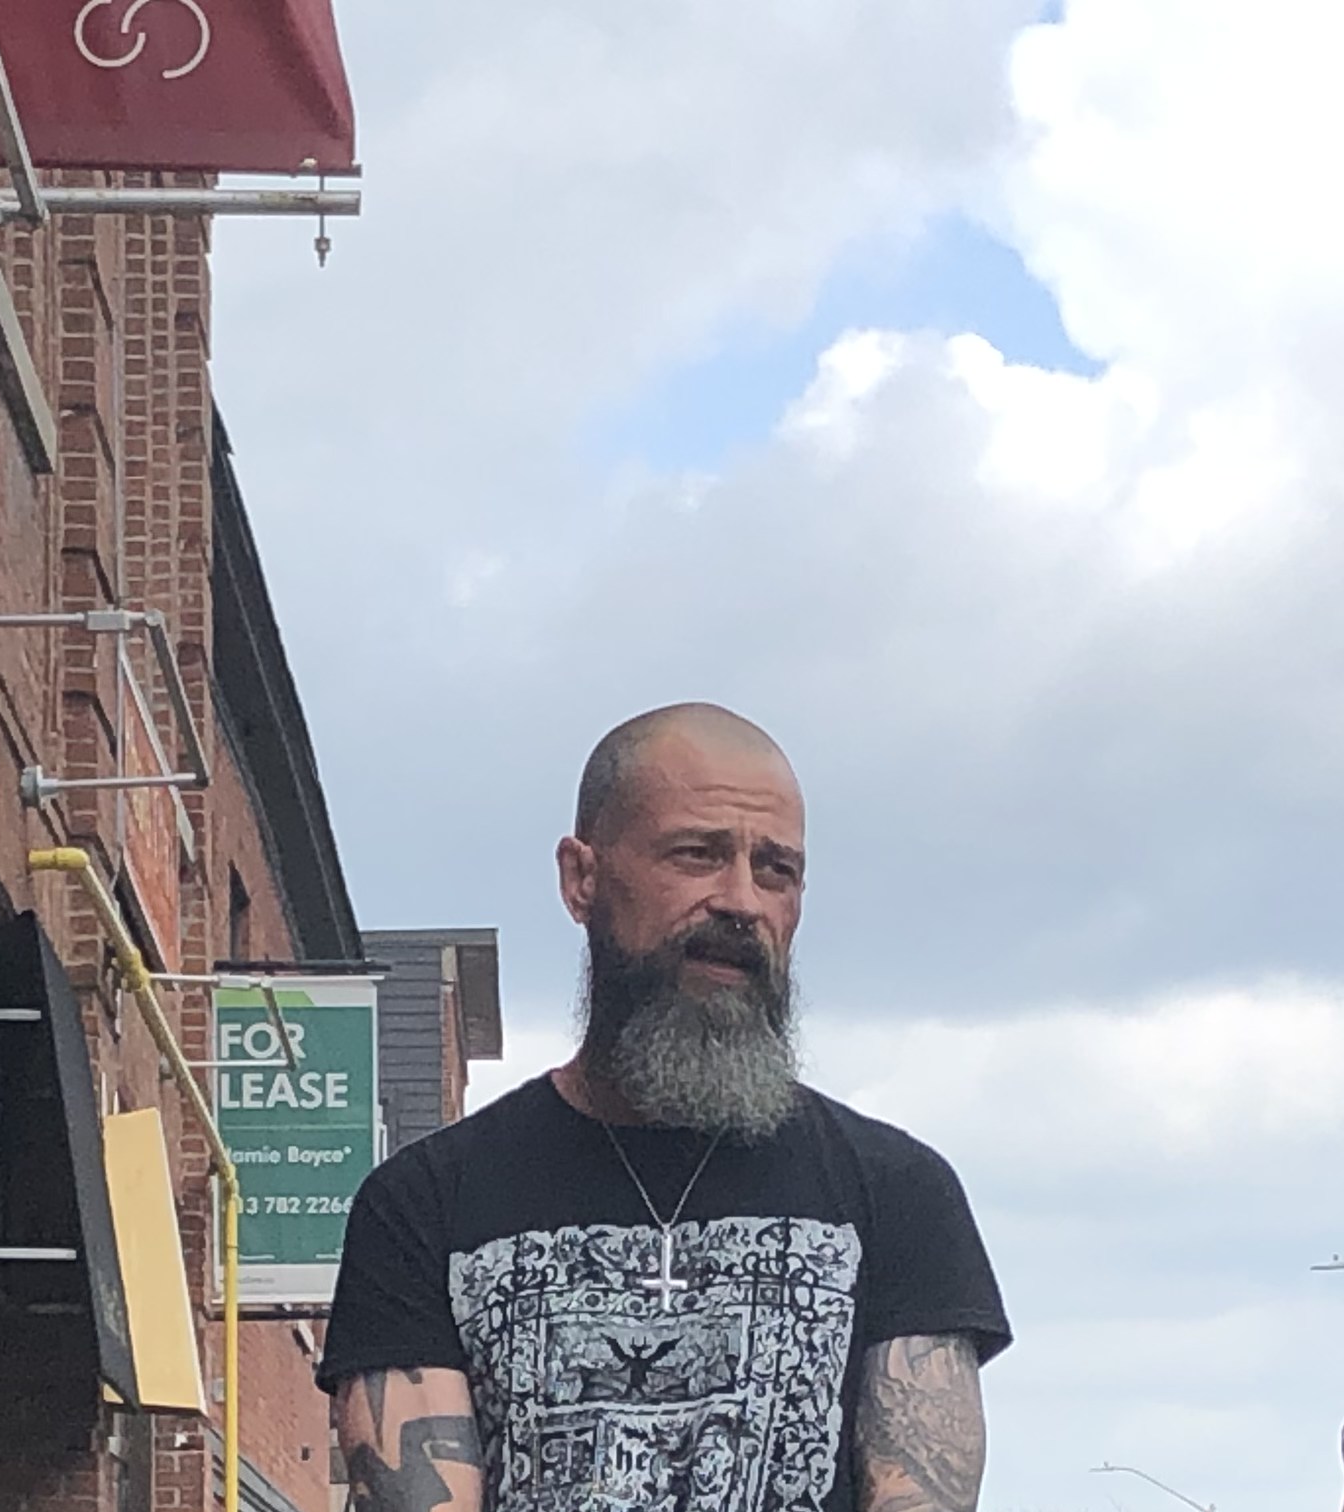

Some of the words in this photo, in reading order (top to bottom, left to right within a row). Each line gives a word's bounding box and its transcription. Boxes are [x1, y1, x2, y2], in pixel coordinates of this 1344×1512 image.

[220, 1022, 306, 1060] FOR
[221, 1072, 348, 1110] LEASE
[264, 1196, 301, 1214] 782
